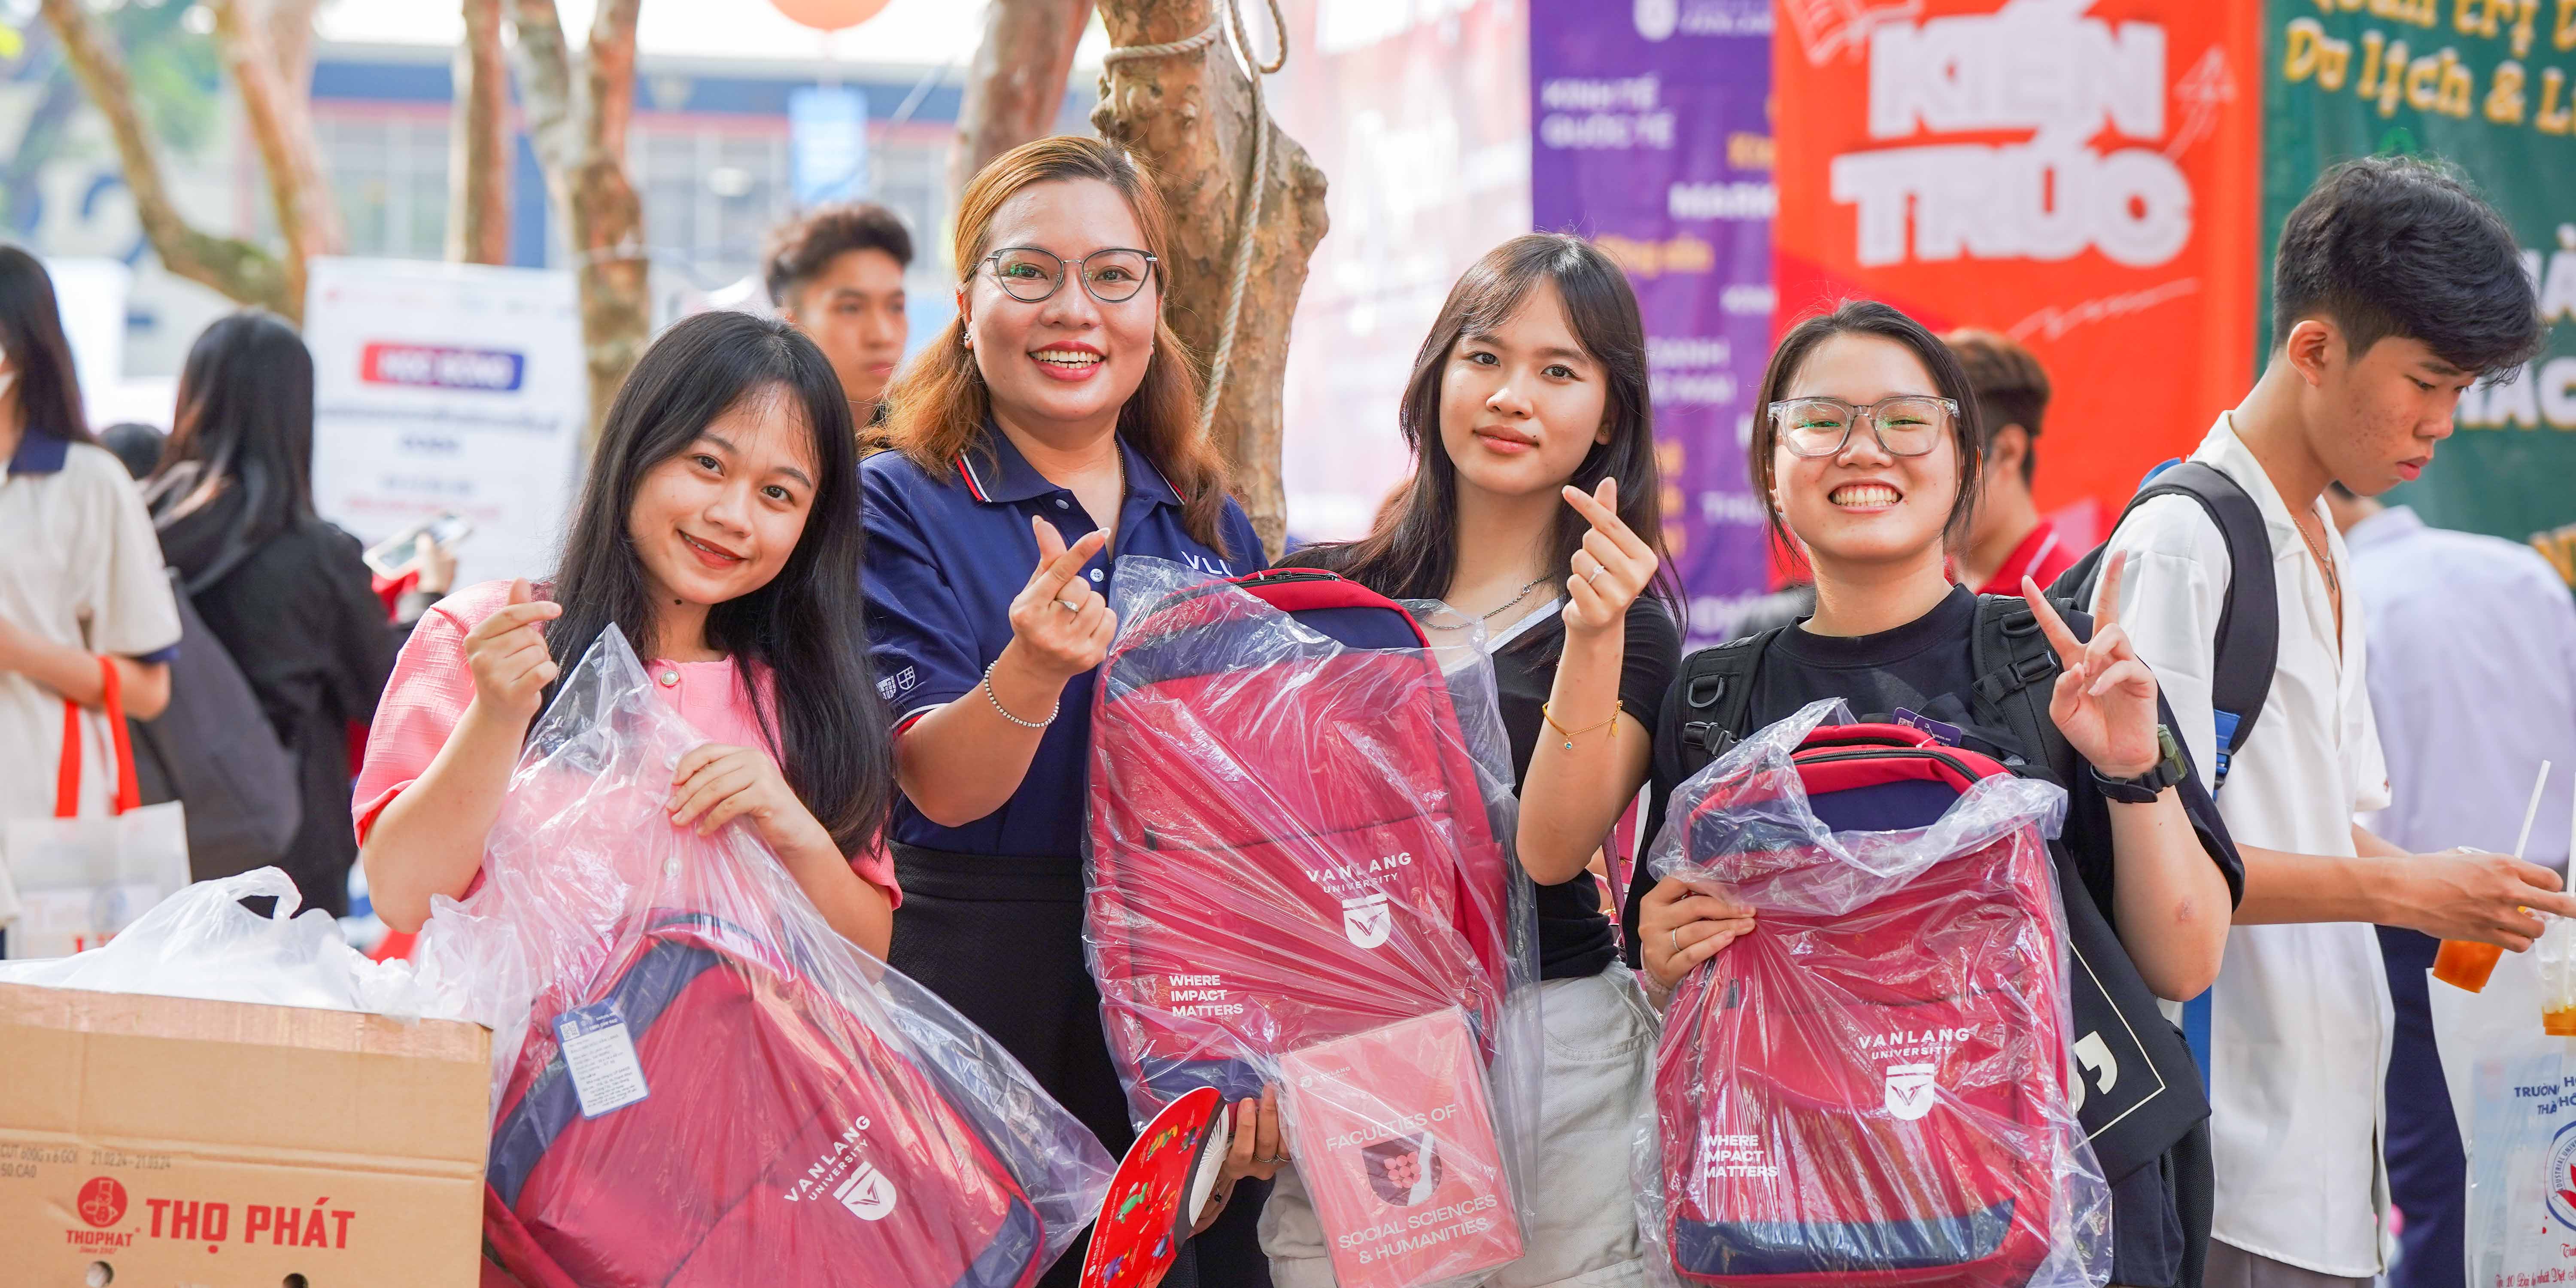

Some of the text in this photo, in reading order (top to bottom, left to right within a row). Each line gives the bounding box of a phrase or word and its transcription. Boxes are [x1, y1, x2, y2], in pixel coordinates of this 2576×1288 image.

[2284, 16, 2576, 134] Du lịch & L
[1830, 122, 2195, 267] TRÚC
[1323, 872, 1397, 893] UNIVERSITY
[1169, 975, 1221, 986] WHERE
[1171, 990, 1227, 1002] IMPACT
[1172, 1003, 1243, 1017] MATTERS
[1871, 1046, 1951, 1060] UNIVERSITY
[2514, 1083, 2560, 1097] TRƯỜN
[1325, 1103, 1457, 1151] FACULTIES OF
[1704, 1134, 1759, 1146] WHERE
[1704, 1150, 1764, 1163] IMPACT
[808, 1139, 868, 1201] UNIVERSITY
[1704, 1166, 1778, 1179] MATTERS
[146, 1197, 356, 1254] THỌ PHÁT
[1339, 1194, 1498, 1249] SOCIAL SCIENCES
[66, 1229, 133, 1247] THOPHAT
[1359, 1218, 1489, 1264] & HUMANITIES
